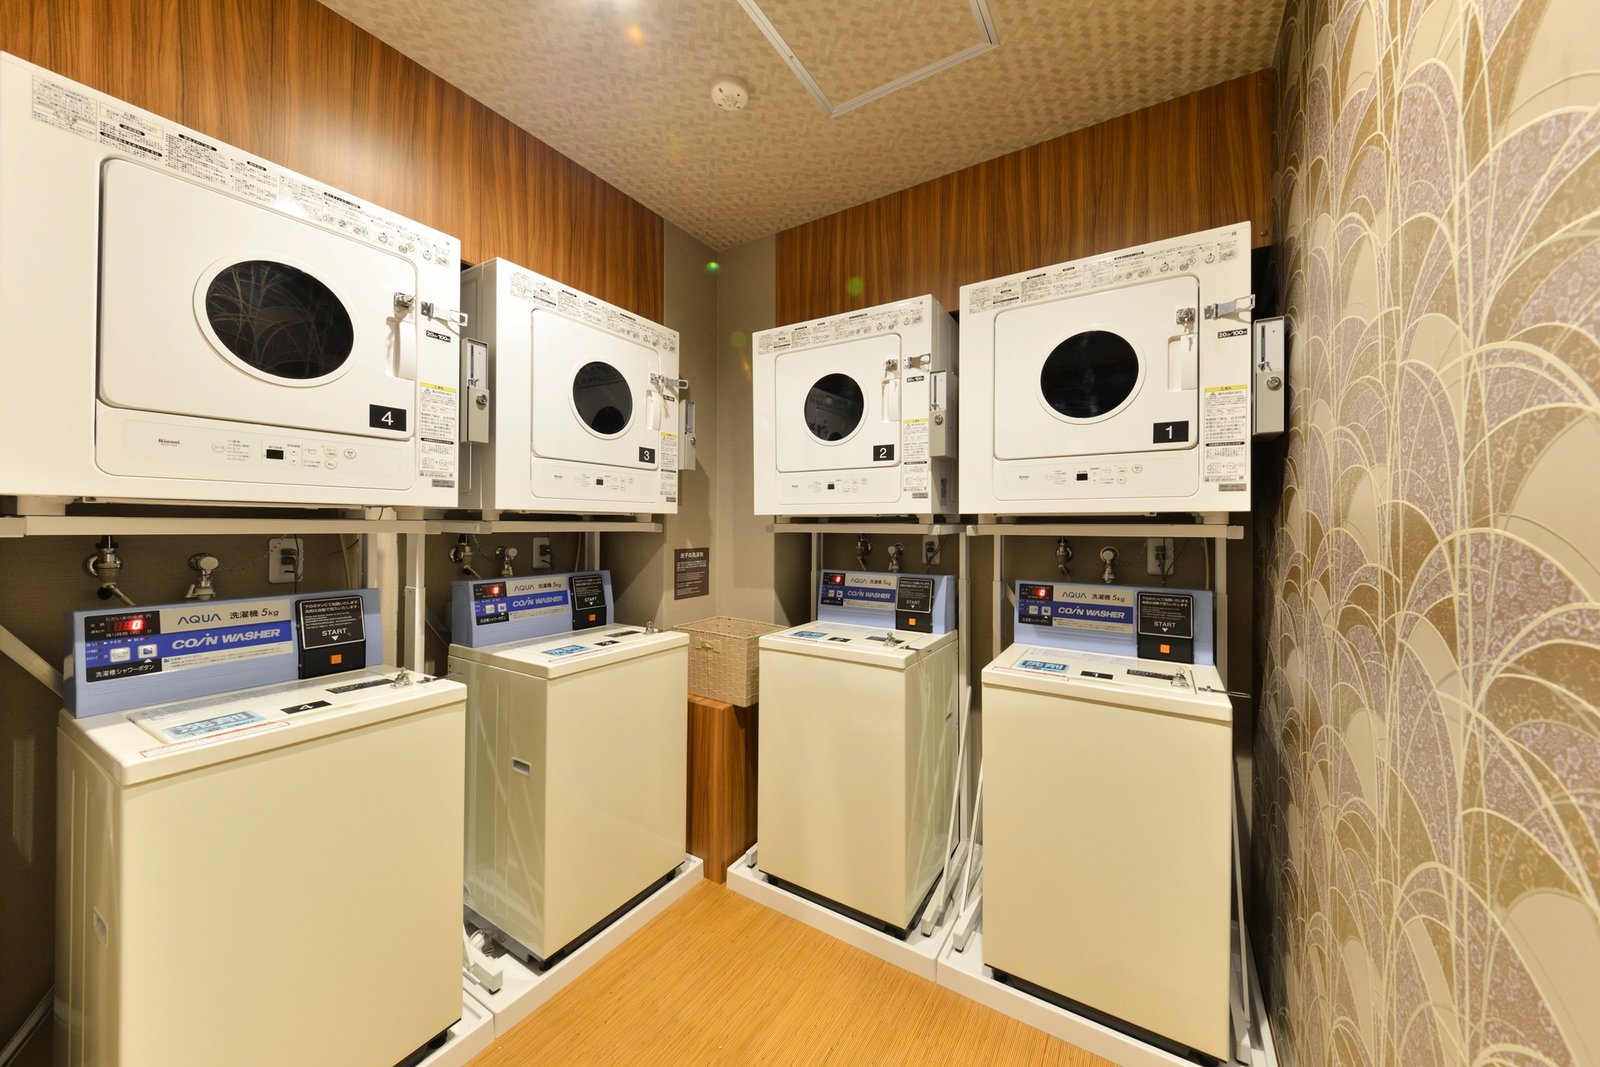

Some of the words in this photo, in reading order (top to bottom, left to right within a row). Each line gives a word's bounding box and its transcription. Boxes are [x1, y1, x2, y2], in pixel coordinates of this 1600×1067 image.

[381, 411, 394, 426] 4
[1166, 426, 1172, 439] 1
[644, 450, 650, 460] 3
[880, 448, 887, 459] 2
[512, 597, 534, 608] COIN
[1112, 594, 1125, 602] 5kg
[178, 614, 222, 625] AQUA
[230, 610, 258, 620] 洗濯機
[261, 608, 279, 617] 5kg
[1058, 606, 1084, 615] COIN
[1086, 609, 1125, 619] WASHER
[132, 620, 142, 630] 0
[322, 628, 347, 637] START
[172, 633, 218, 650] COIN
[222, 628, 280, 644] WASHER
[96, 664, 154, 678] 洗濯機シャワーボタン
